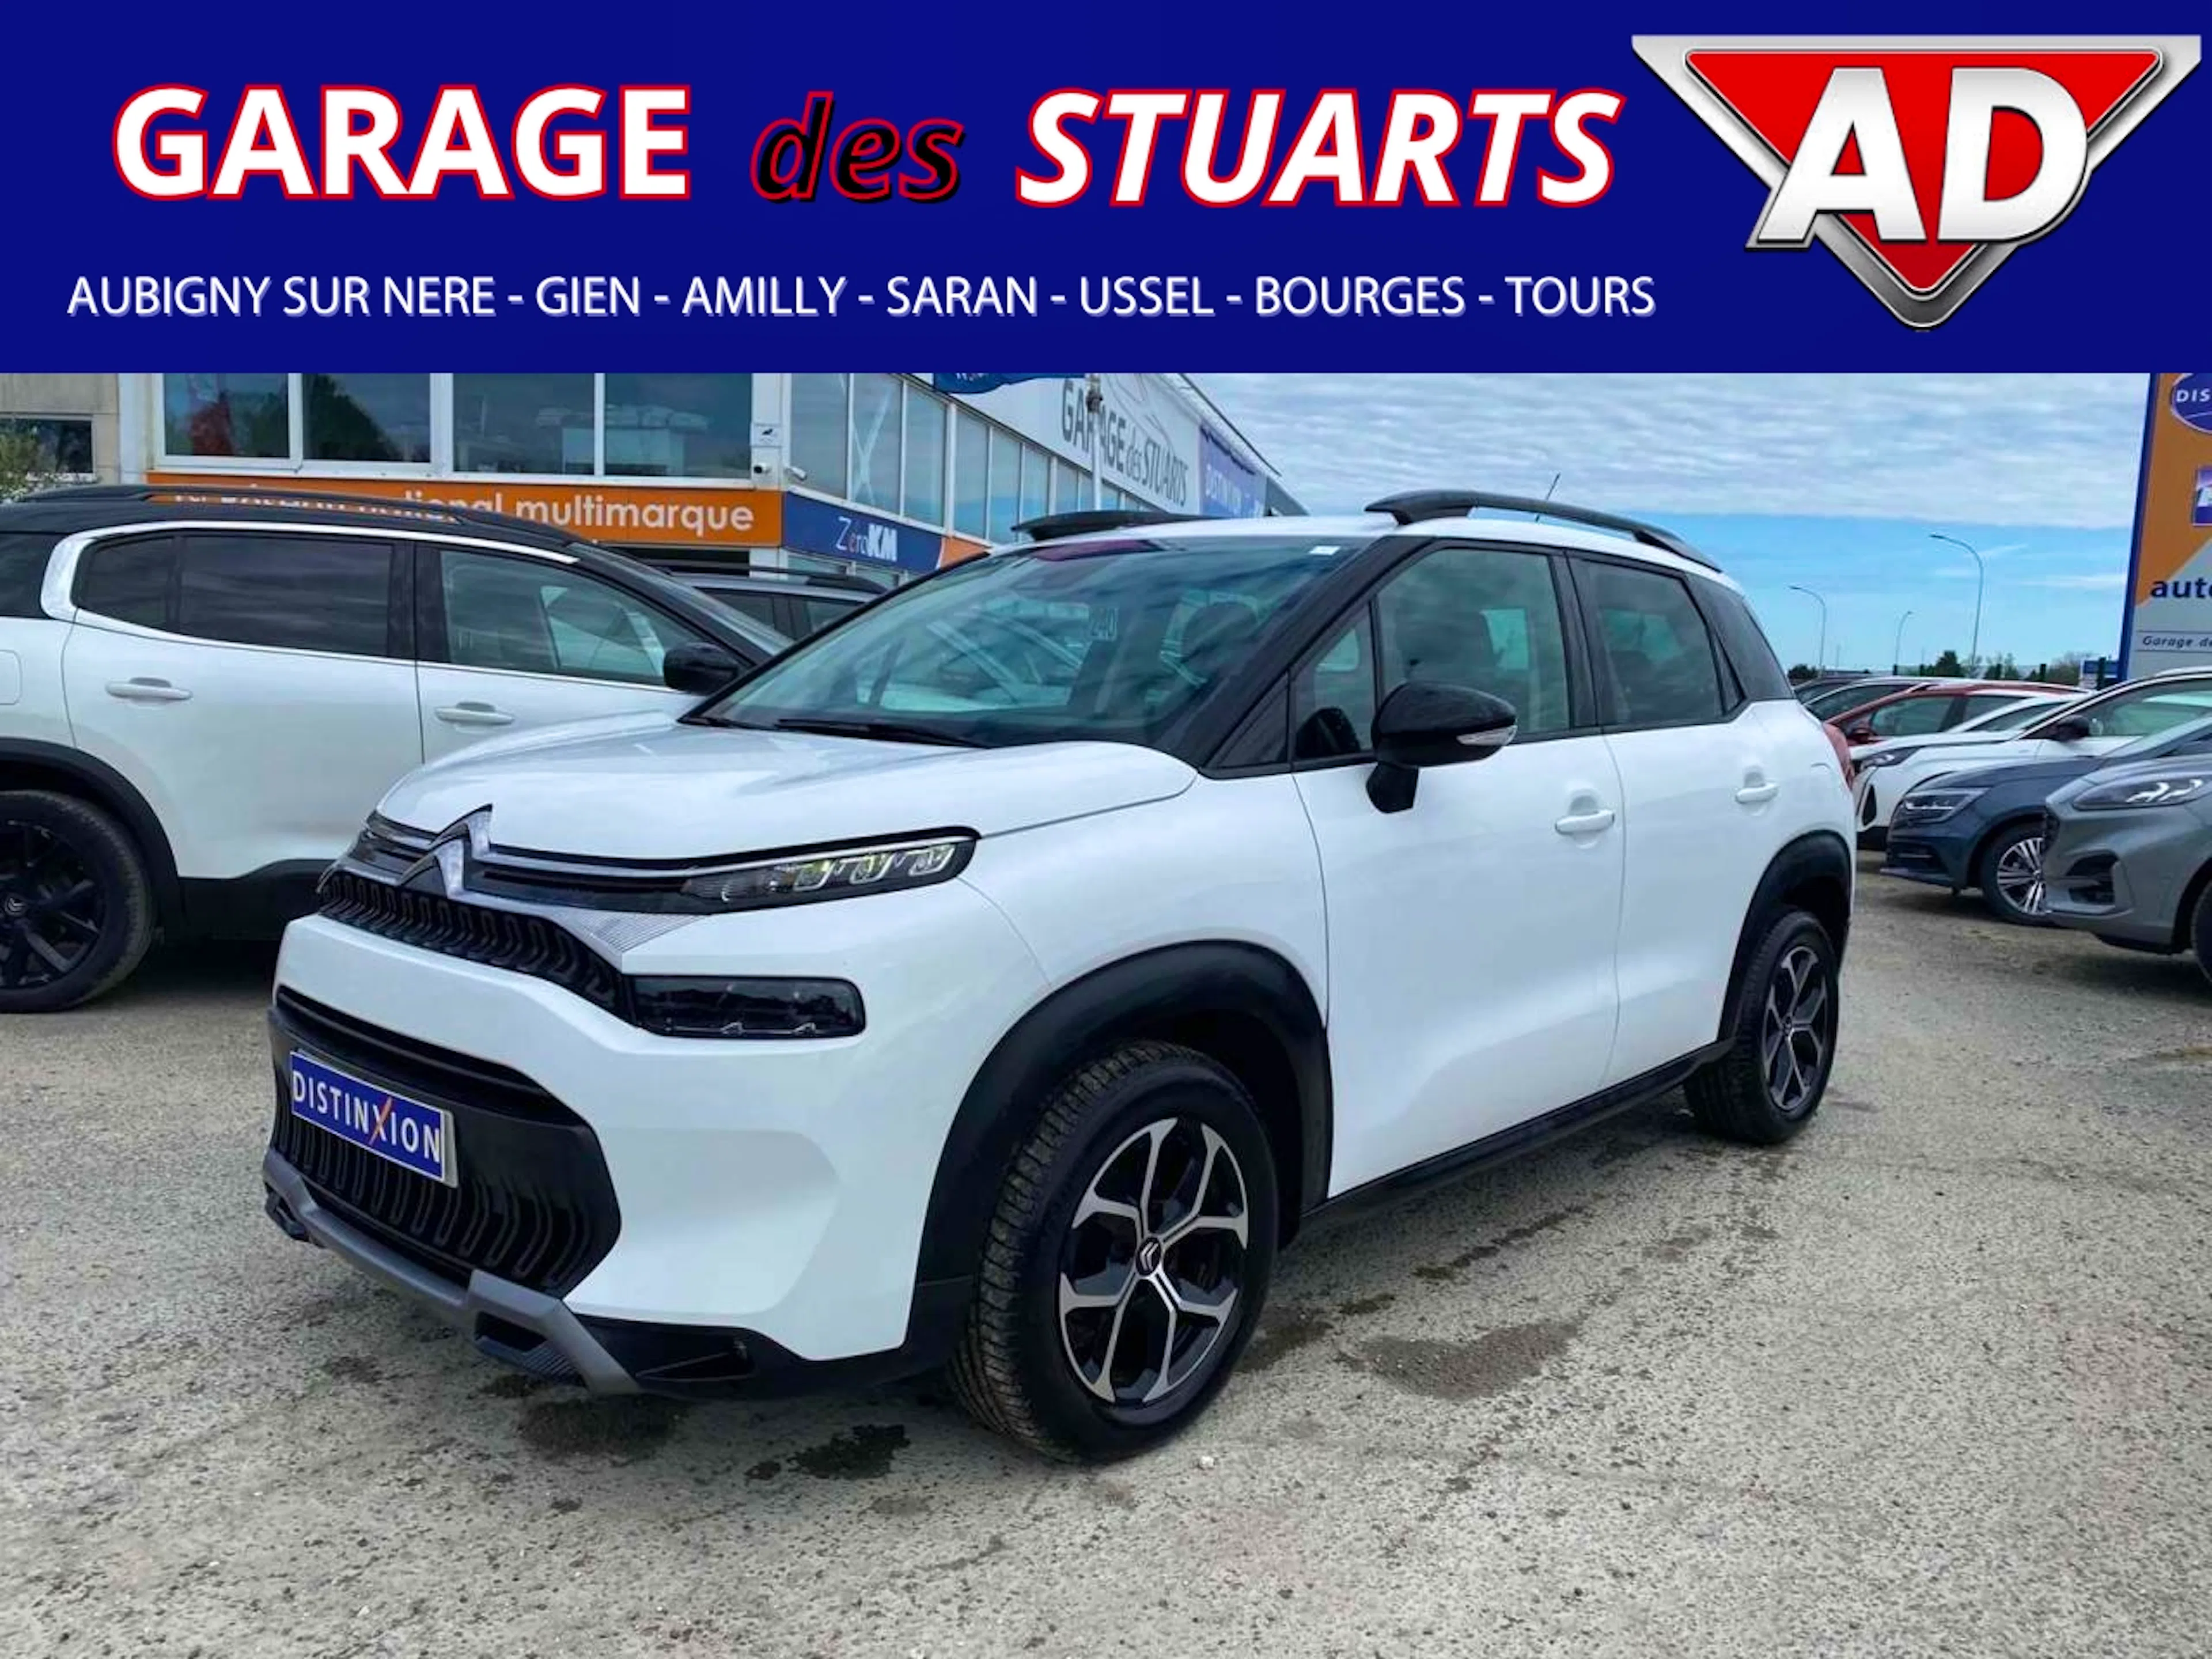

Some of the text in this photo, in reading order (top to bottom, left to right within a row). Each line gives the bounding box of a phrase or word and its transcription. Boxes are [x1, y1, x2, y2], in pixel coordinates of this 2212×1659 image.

[516, 493, 754, 537] multimarque
[2143, 636, 2193, 648] Garage
[292, 1070, 440, 1162] DISTINXION
